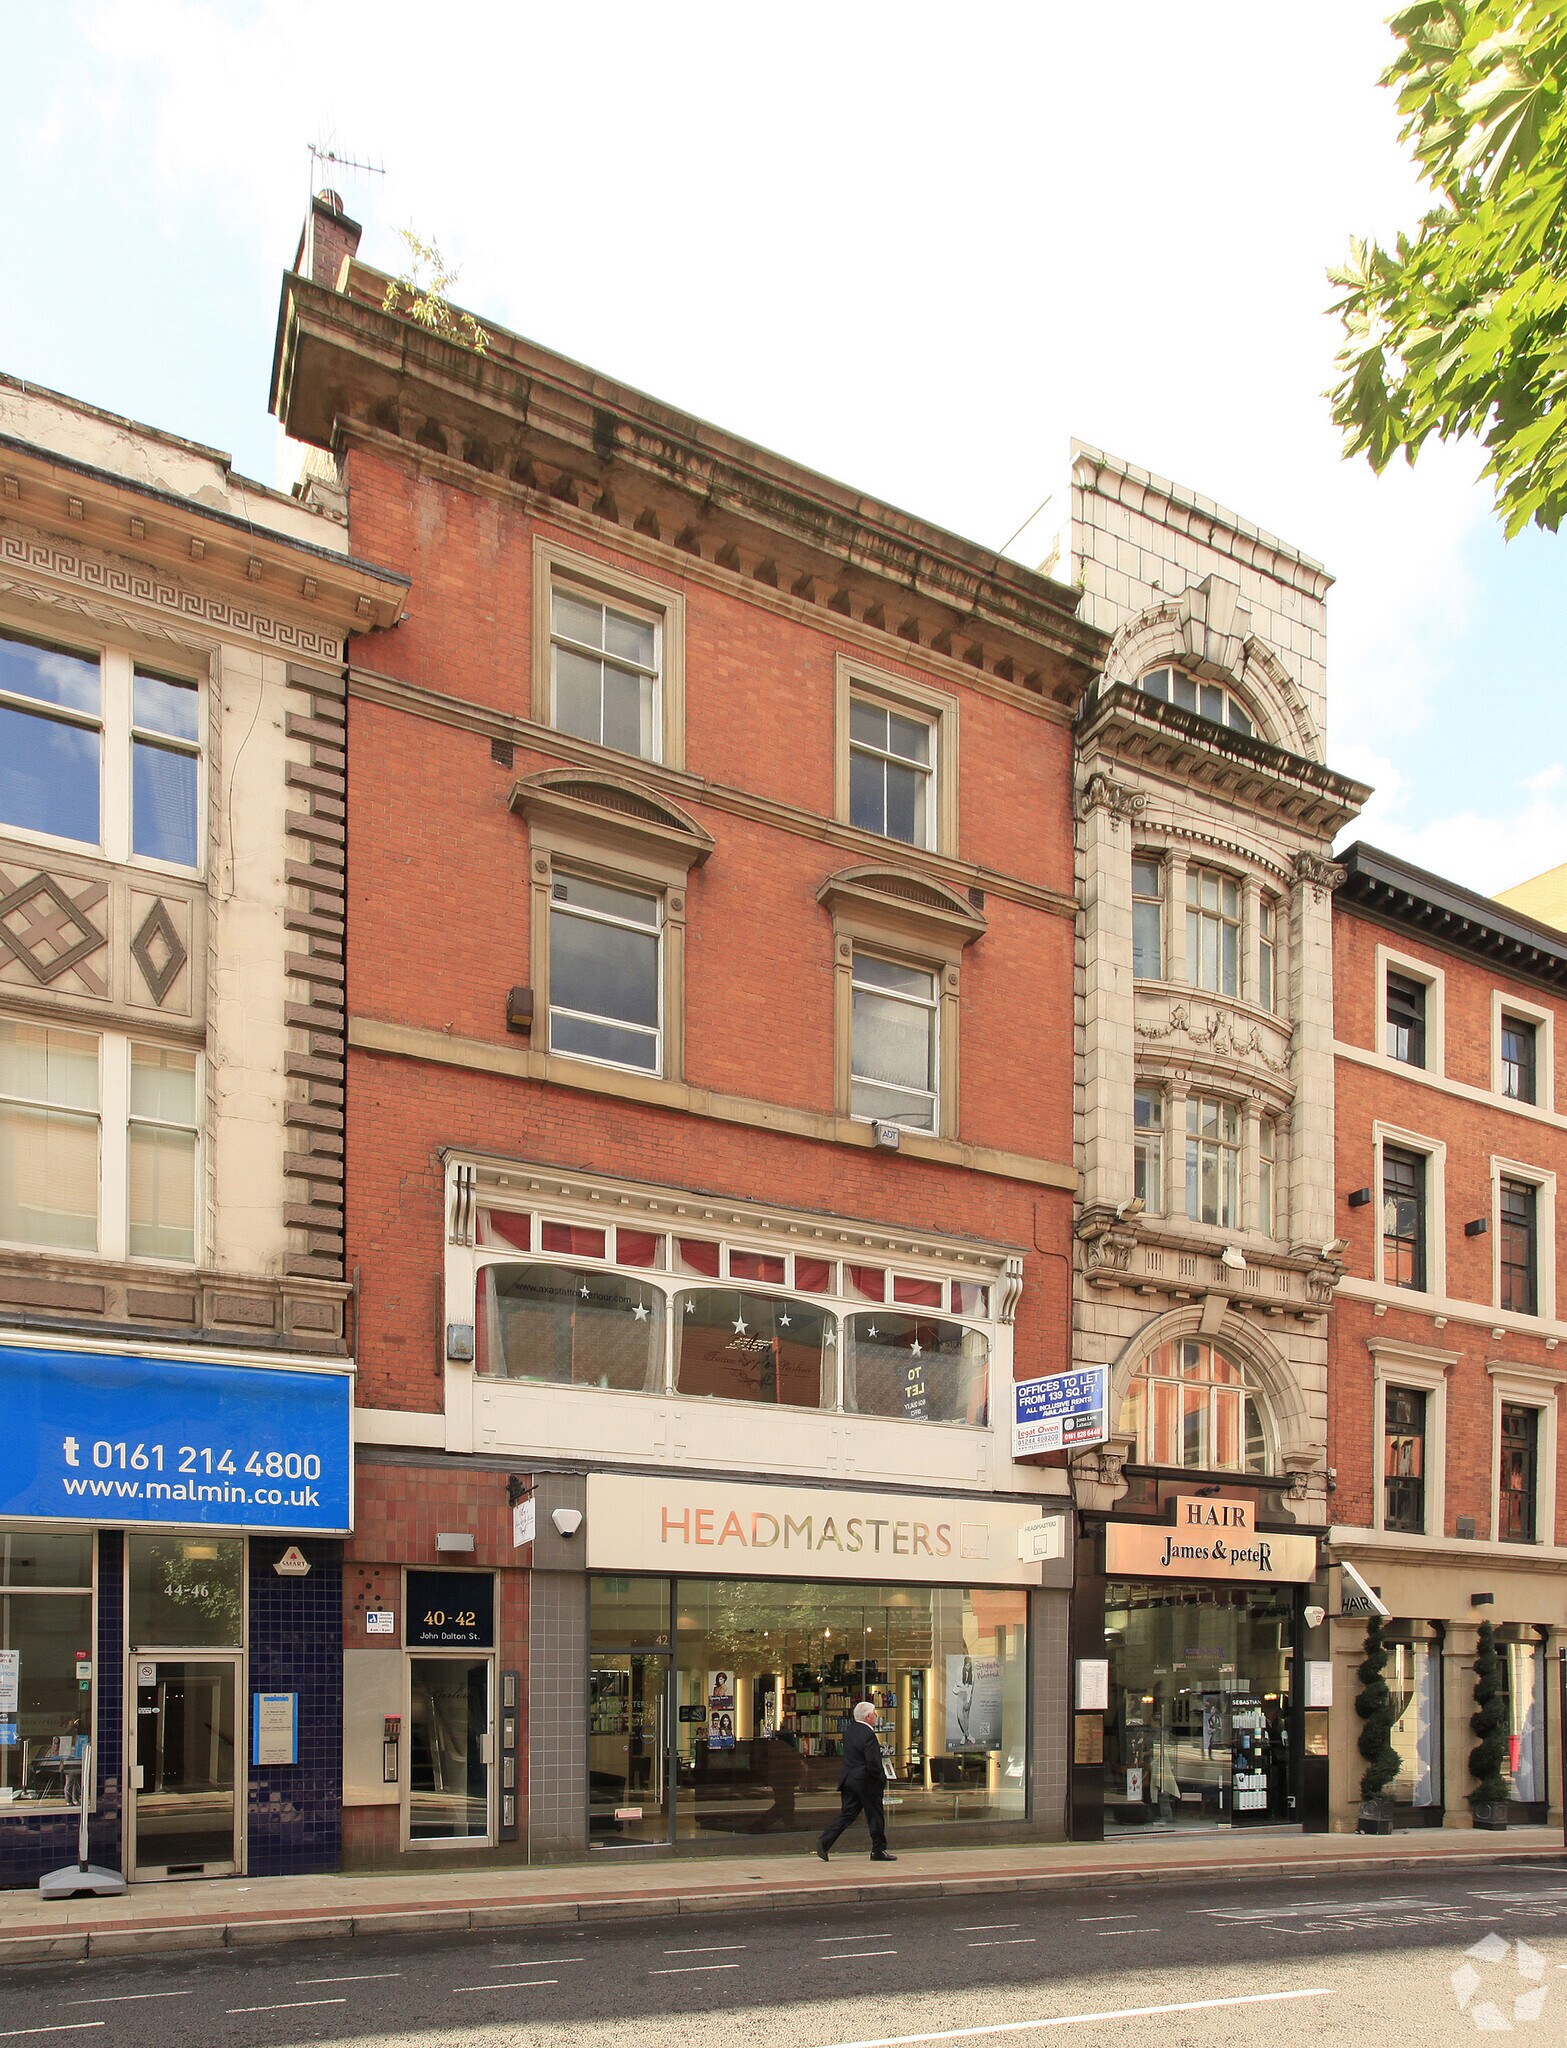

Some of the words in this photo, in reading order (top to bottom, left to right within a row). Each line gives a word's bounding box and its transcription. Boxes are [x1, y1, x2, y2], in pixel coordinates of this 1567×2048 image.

[882, 1130, 897, 1140] ADT
[1018, 1381, 1060, 1397] OFFICES
[1063, 1377, 1077, 1388] TO
[1080, 1372, 1100, 1385] LET
[1019, 1393, 1046, 1407] FROM
[1048, 1390, 1063, 1401] 139
[1039, 1400, 1070, 1412] INCLUSIVE
[1071, 1396, 1093, 1406] RENTS
[1042, 1405, 1075, 1417] AVAILABLE
[1017, 1428, 1036, 1440] Legat
[1037, 1425, 1059, 1434] Owen
[62, 1436, 80, 1466] t
[92, 1441, 164, 1471] 0161
[178, 1446, 237, 1475] 214
[245, 1451, 321, 1480] 4800
[62, 1478, 320, 1507] www.malmin.co.uk
[1185, 1503, 1247, 1527] HAIR
[661, 1506, 953, 1557] HEADMASTERS
[1025, 1520, 1057, 1532] HEADMASTERS
[1160, 1535, 1209, 1567] James
[1211, 1539, 1227, 1560] &
[164, 1584, 209, 1598] 44-46
[1341, 1596, 1371, 1612] HAIR
[420, 1631, 439, 1640] John
[441, 1632, 466, 1640] Dalton
[468, 1632, 481, 1640] St.
[655, 1634, 669, 1646] 42
[596, 1700, 650, 1708] HEADMASTERS
